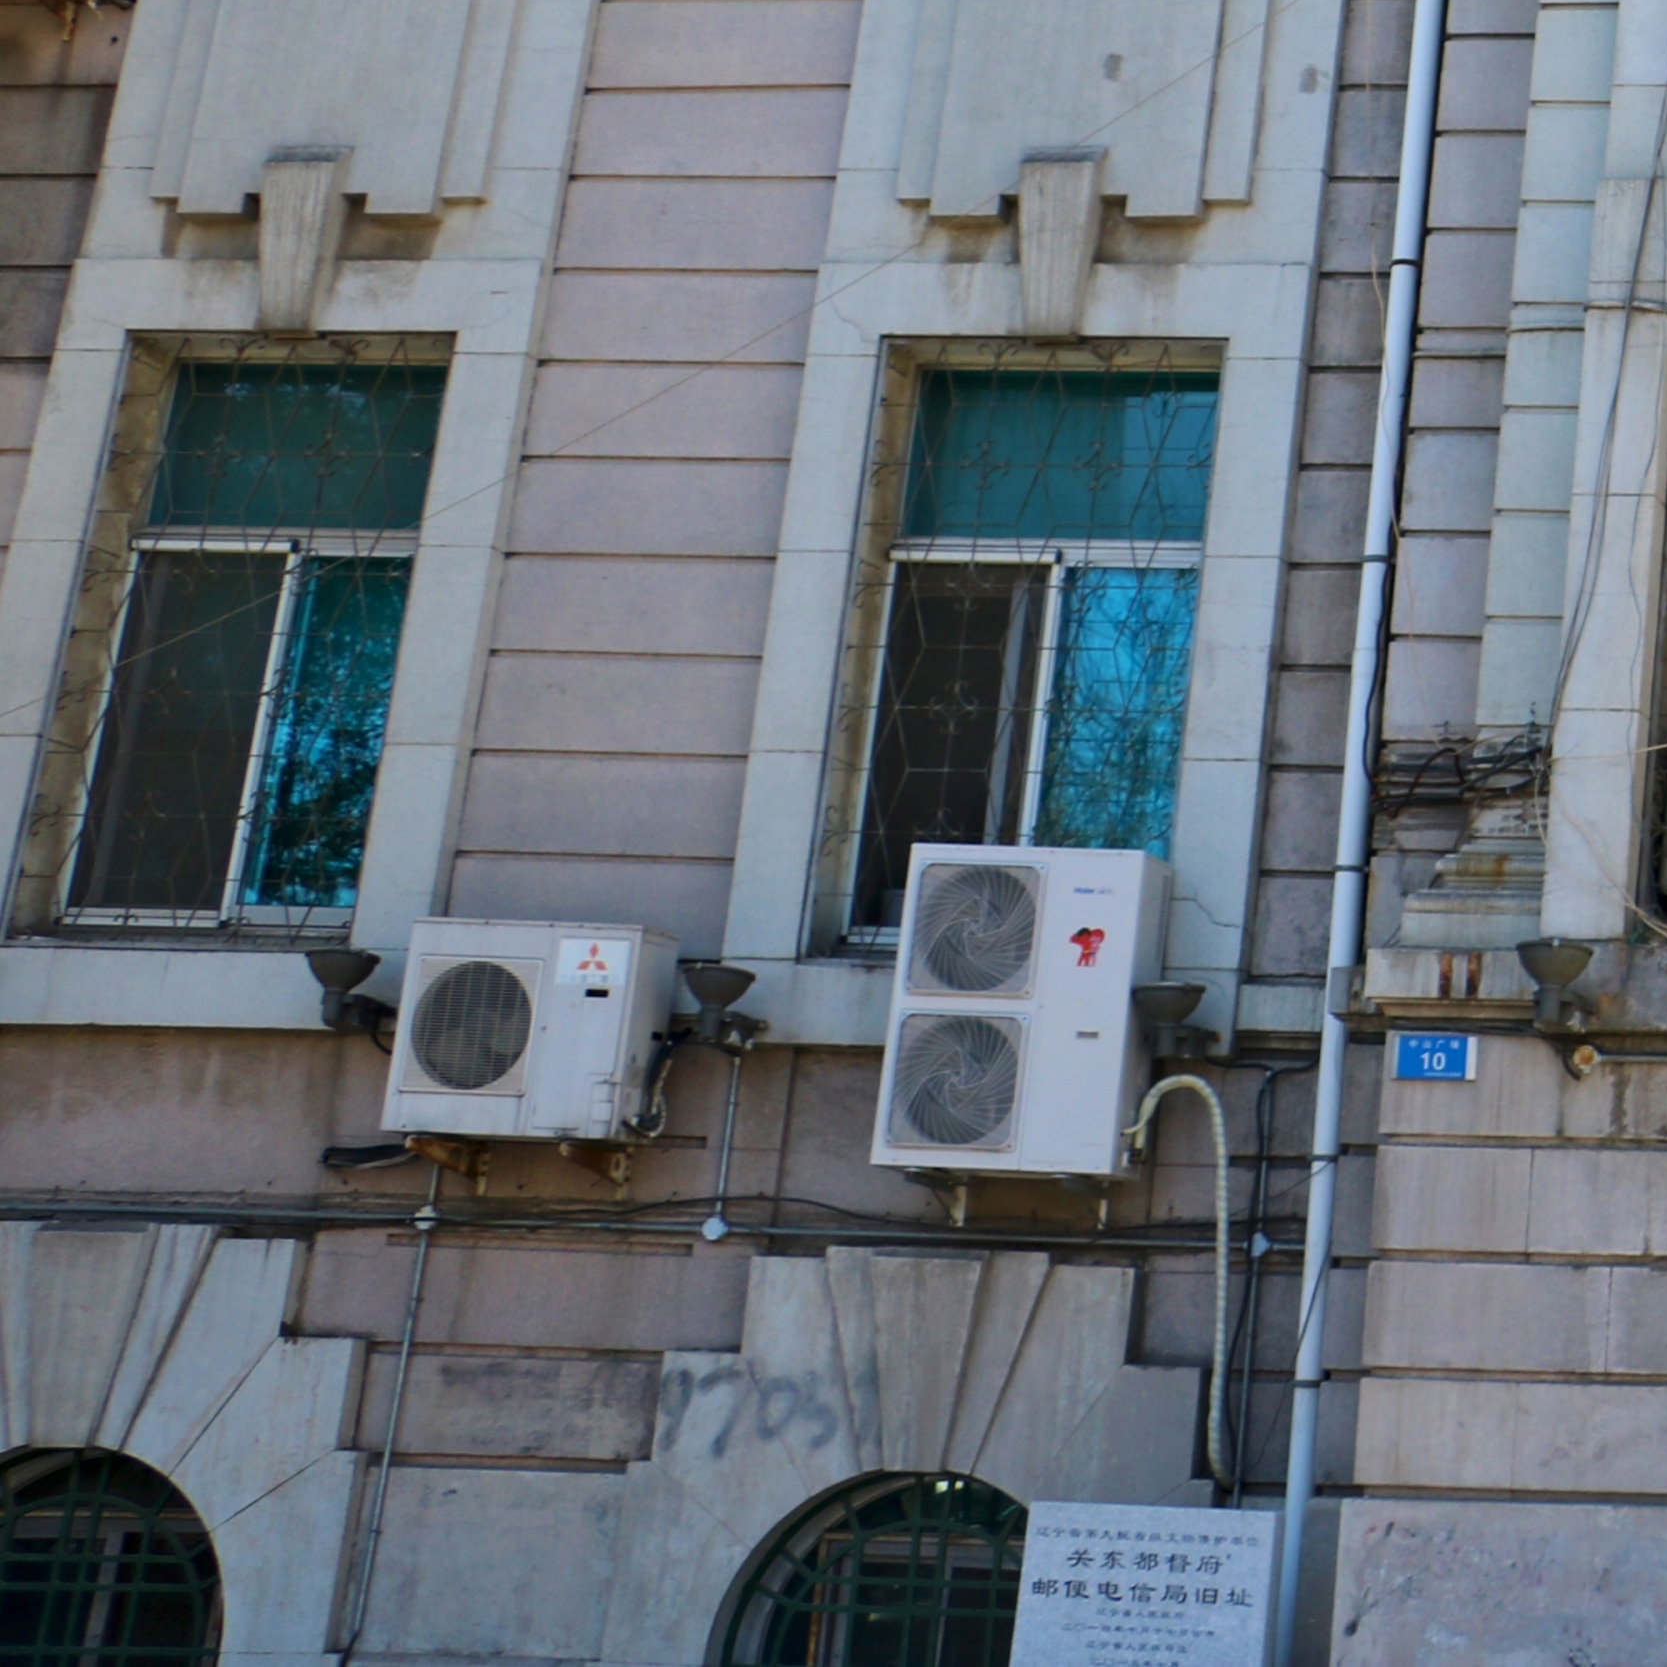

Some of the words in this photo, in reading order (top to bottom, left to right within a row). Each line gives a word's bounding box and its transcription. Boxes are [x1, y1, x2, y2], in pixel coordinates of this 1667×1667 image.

[1420, 1051, 1447, 1071] 10
[1066, 1548, 1225, 1575] 关东都督府
[1031, 1577, 1254, 1608] 邮便电信局旧址
